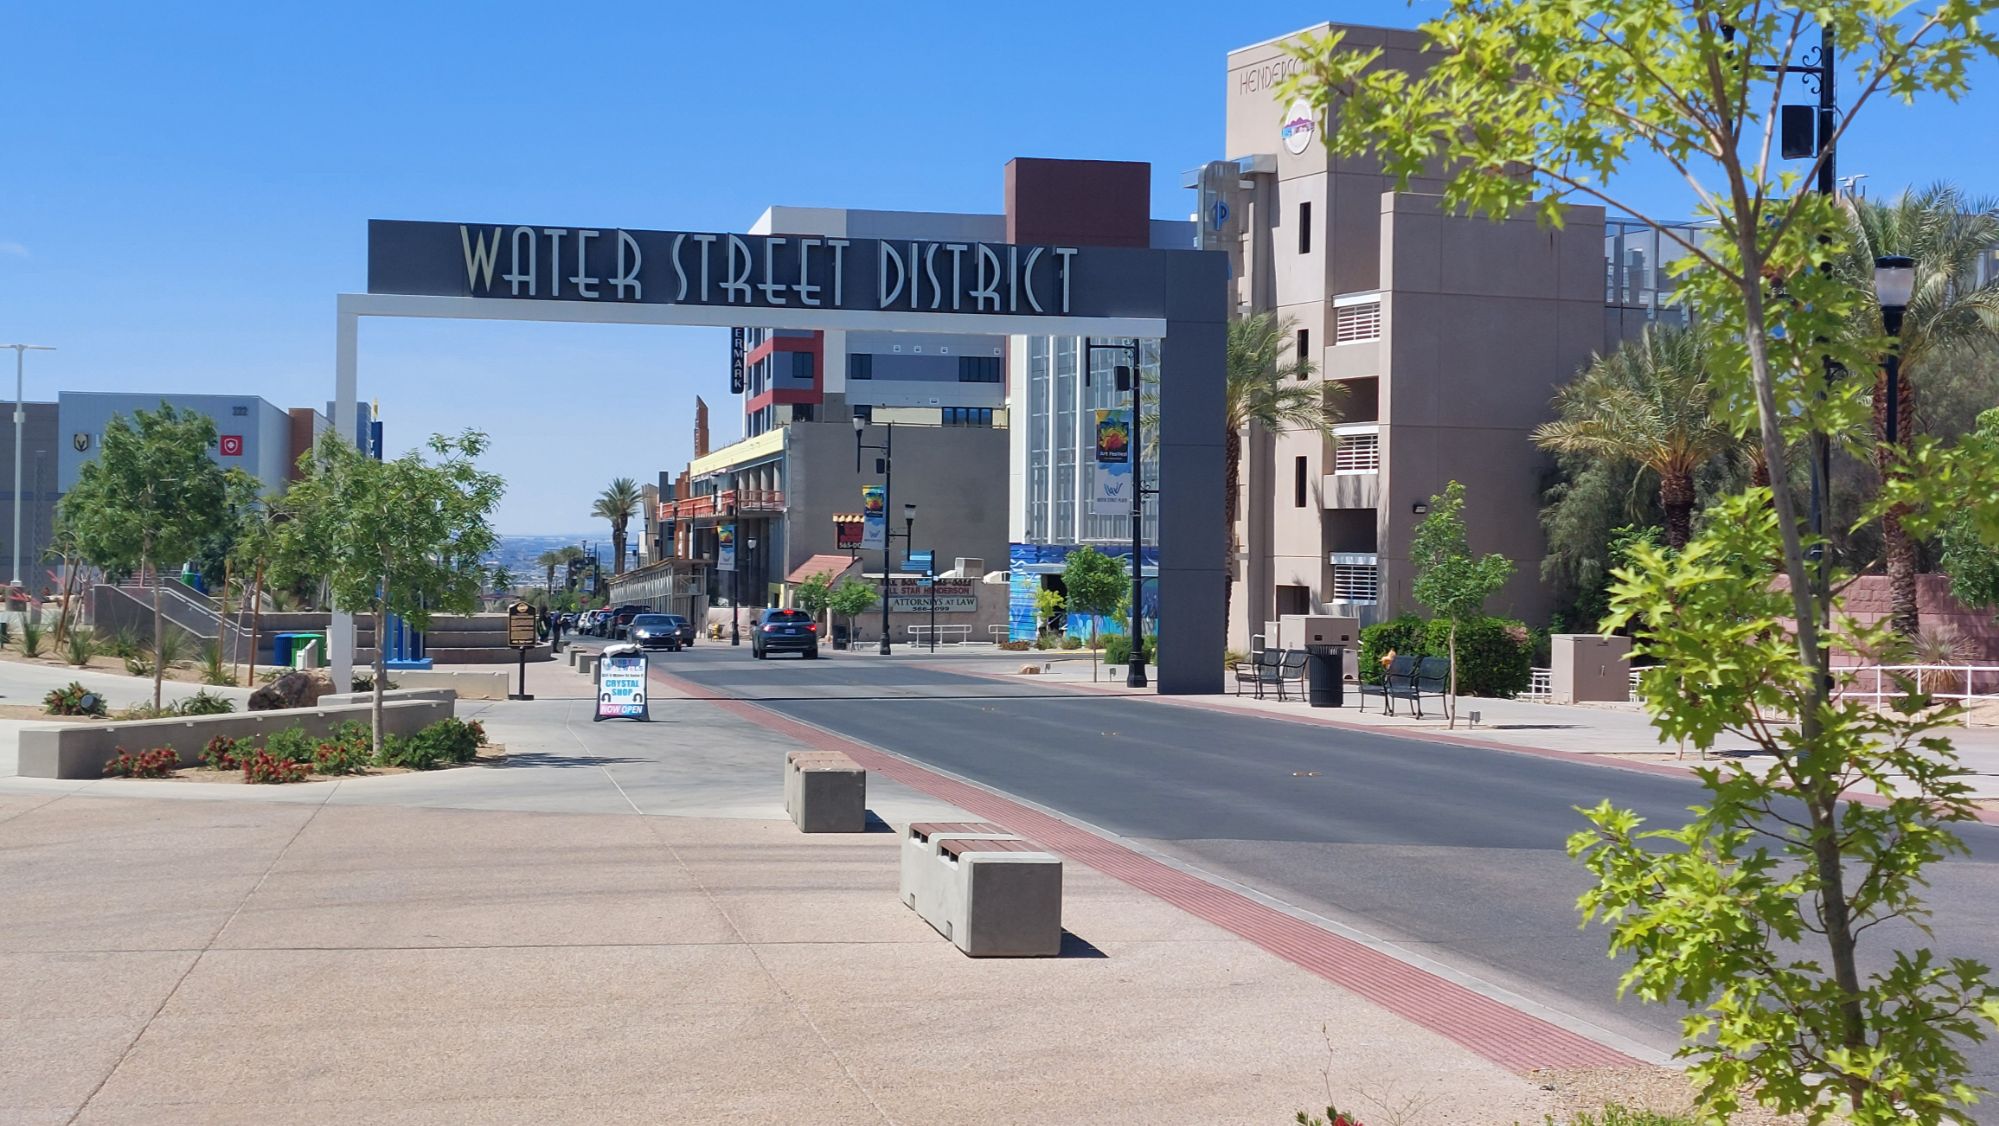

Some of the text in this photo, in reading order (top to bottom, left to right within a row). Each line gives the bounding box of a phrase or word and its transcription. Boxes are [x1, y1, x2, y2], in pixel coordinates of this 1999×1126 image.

[1239, 57, 1311, 96] HENDERSO
[459, 224, 1079, 313] WATER STREET DISTRICT
[601, 705, 643, 713] NOW OPEN
